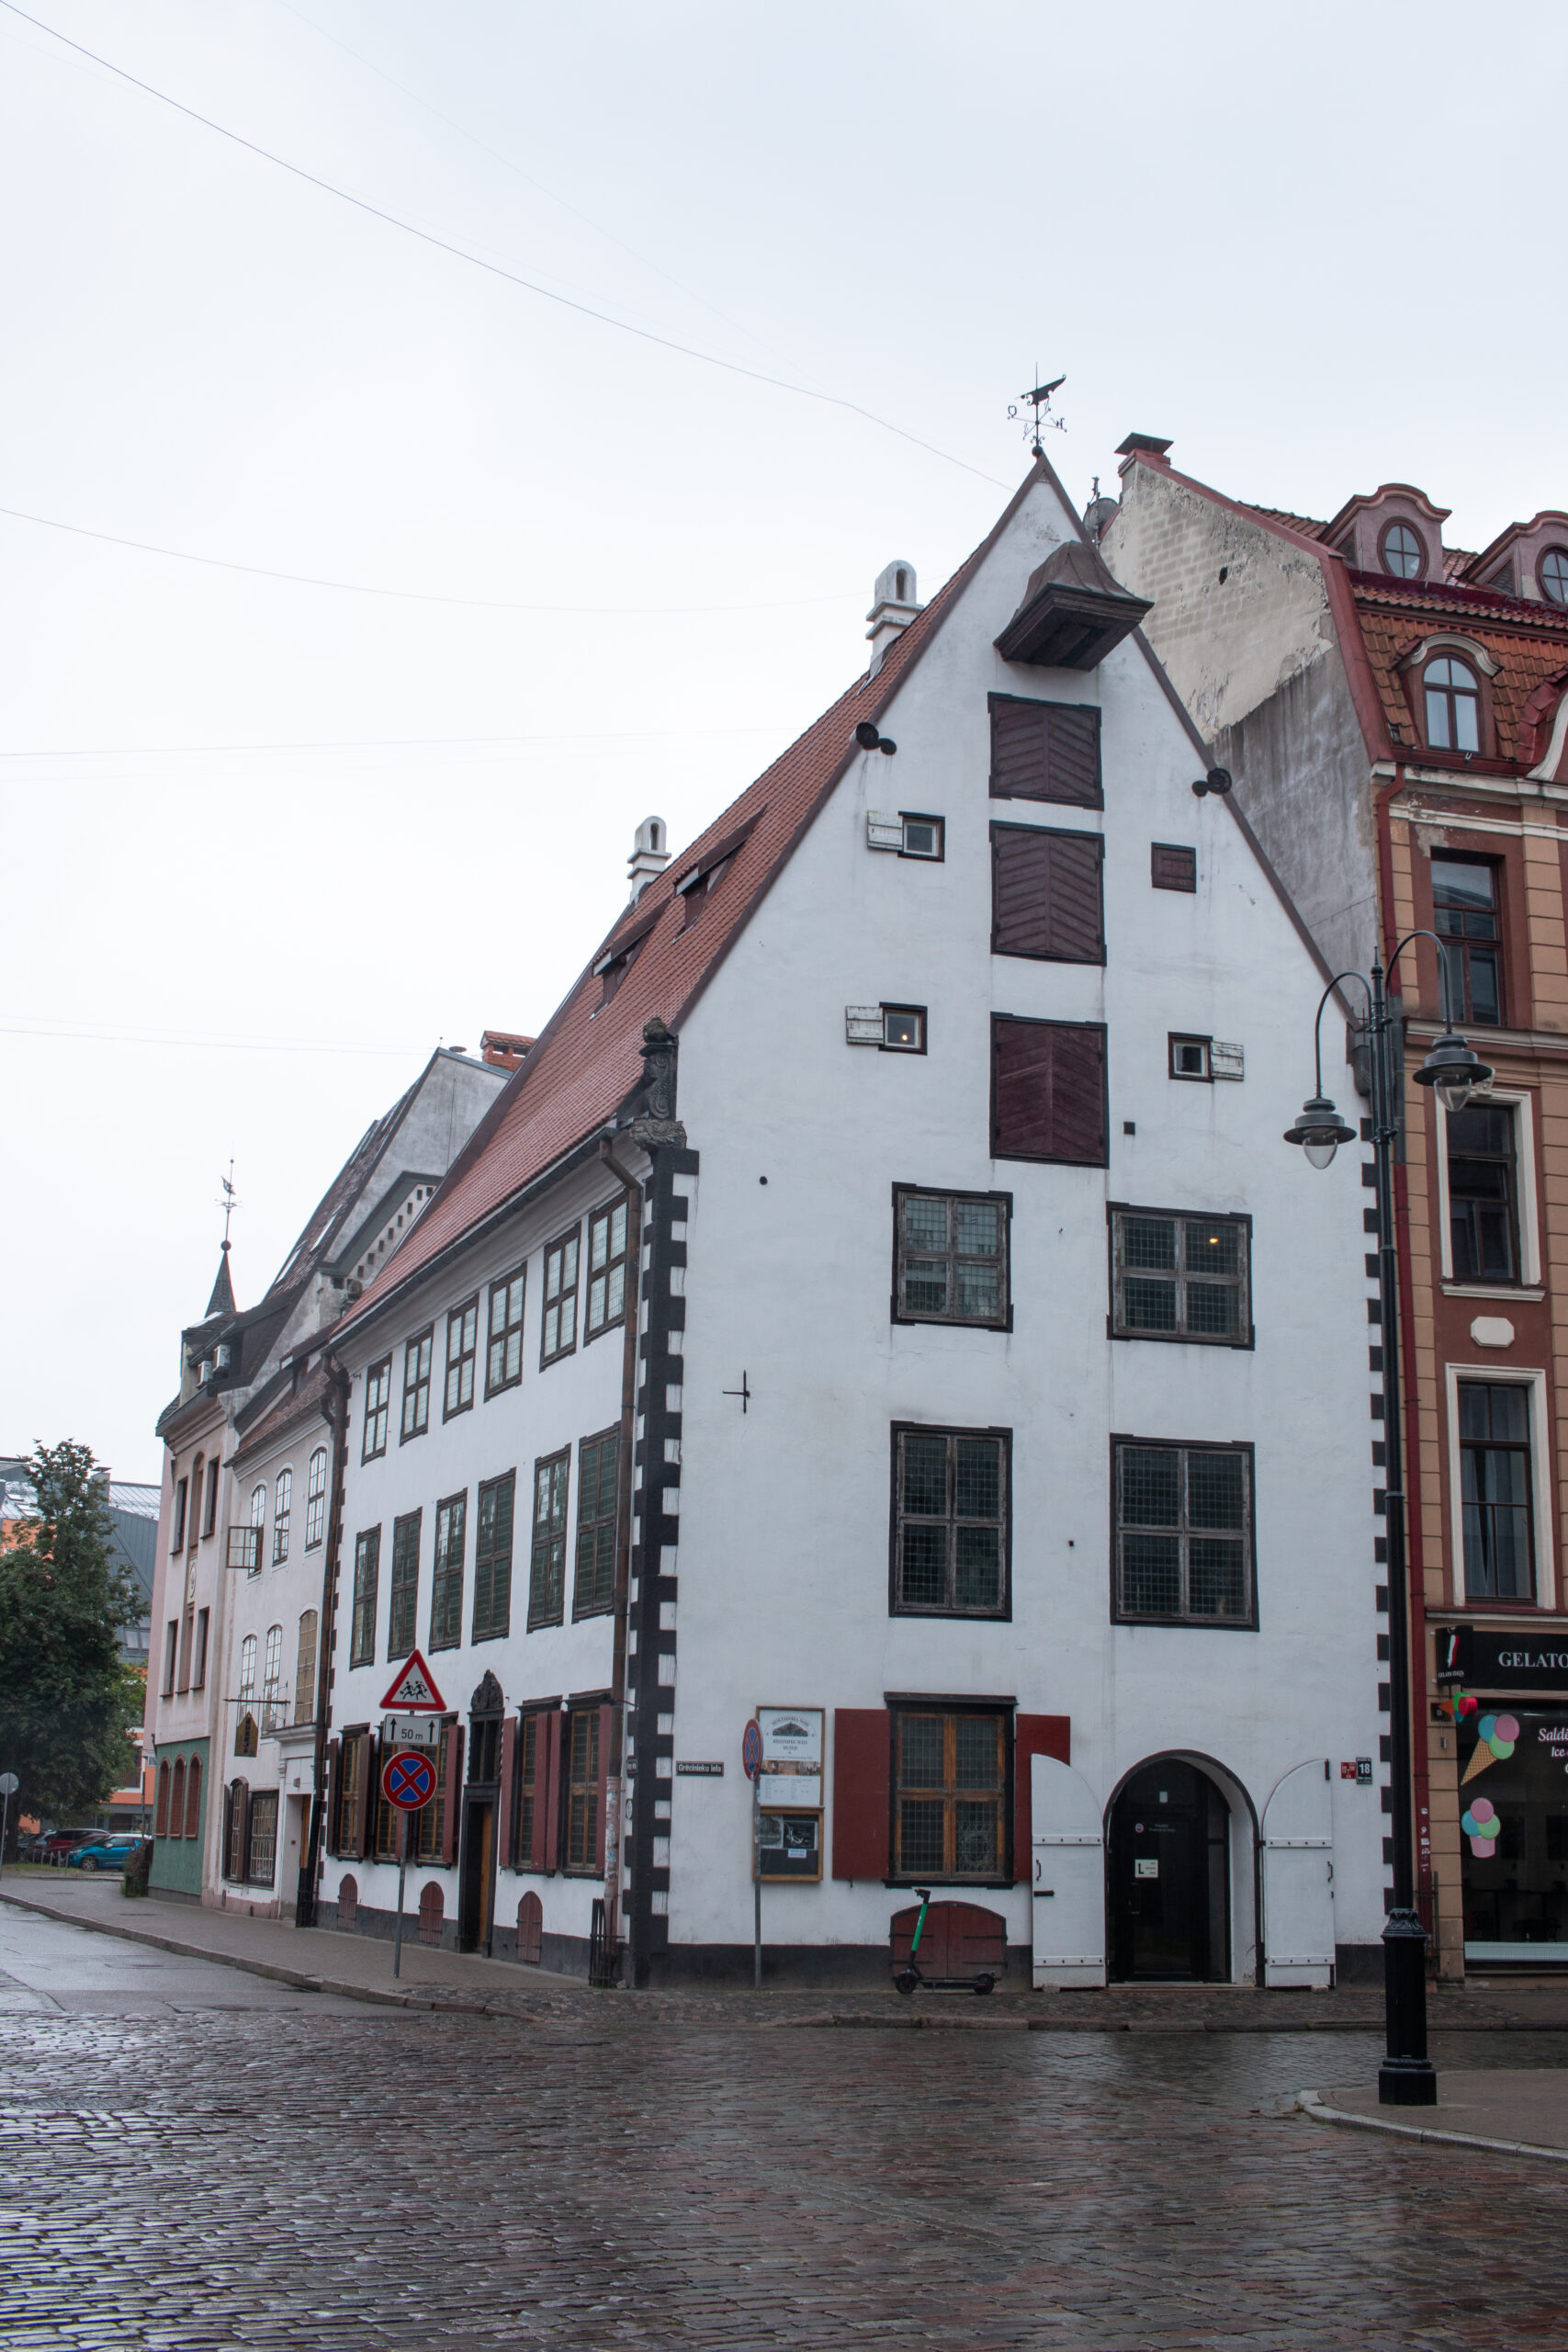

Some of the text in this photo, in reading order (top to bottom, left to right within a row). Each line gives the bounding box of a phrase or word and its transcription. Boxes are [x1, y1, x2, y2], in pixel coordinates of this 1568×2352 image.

[1498, 1651, 1568, 1668] GELATO
[401, 1729, 413, 1739] 50
[1551, 1746, 1565, 1757] Ice
[710, 1764, 722, 1772] iela
[1359, 1763, 1370, 1774] 18
